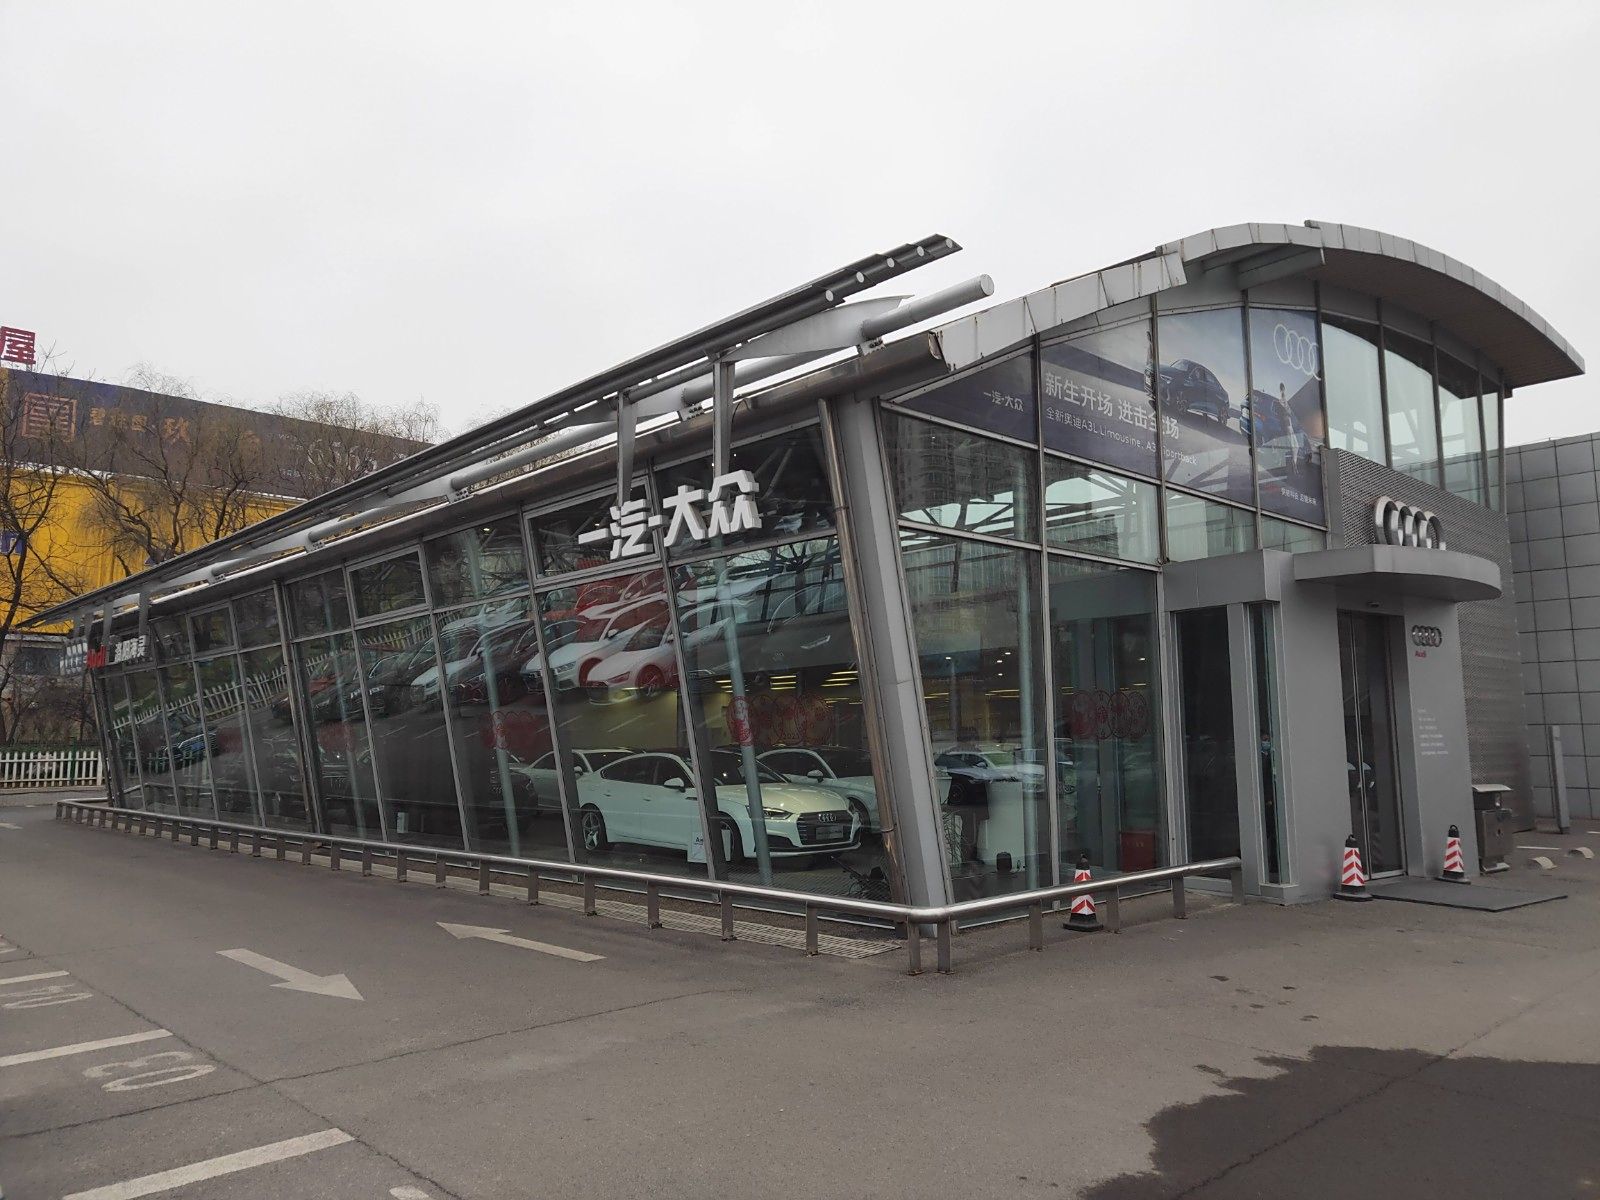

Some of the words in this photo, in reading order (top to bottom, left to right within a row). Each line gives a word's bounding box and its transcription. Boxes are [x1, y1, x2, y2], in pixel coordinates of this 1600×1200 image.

[0, 326, 36, 364] 屋
[1045, 372, 1113, 417] 新生开场
